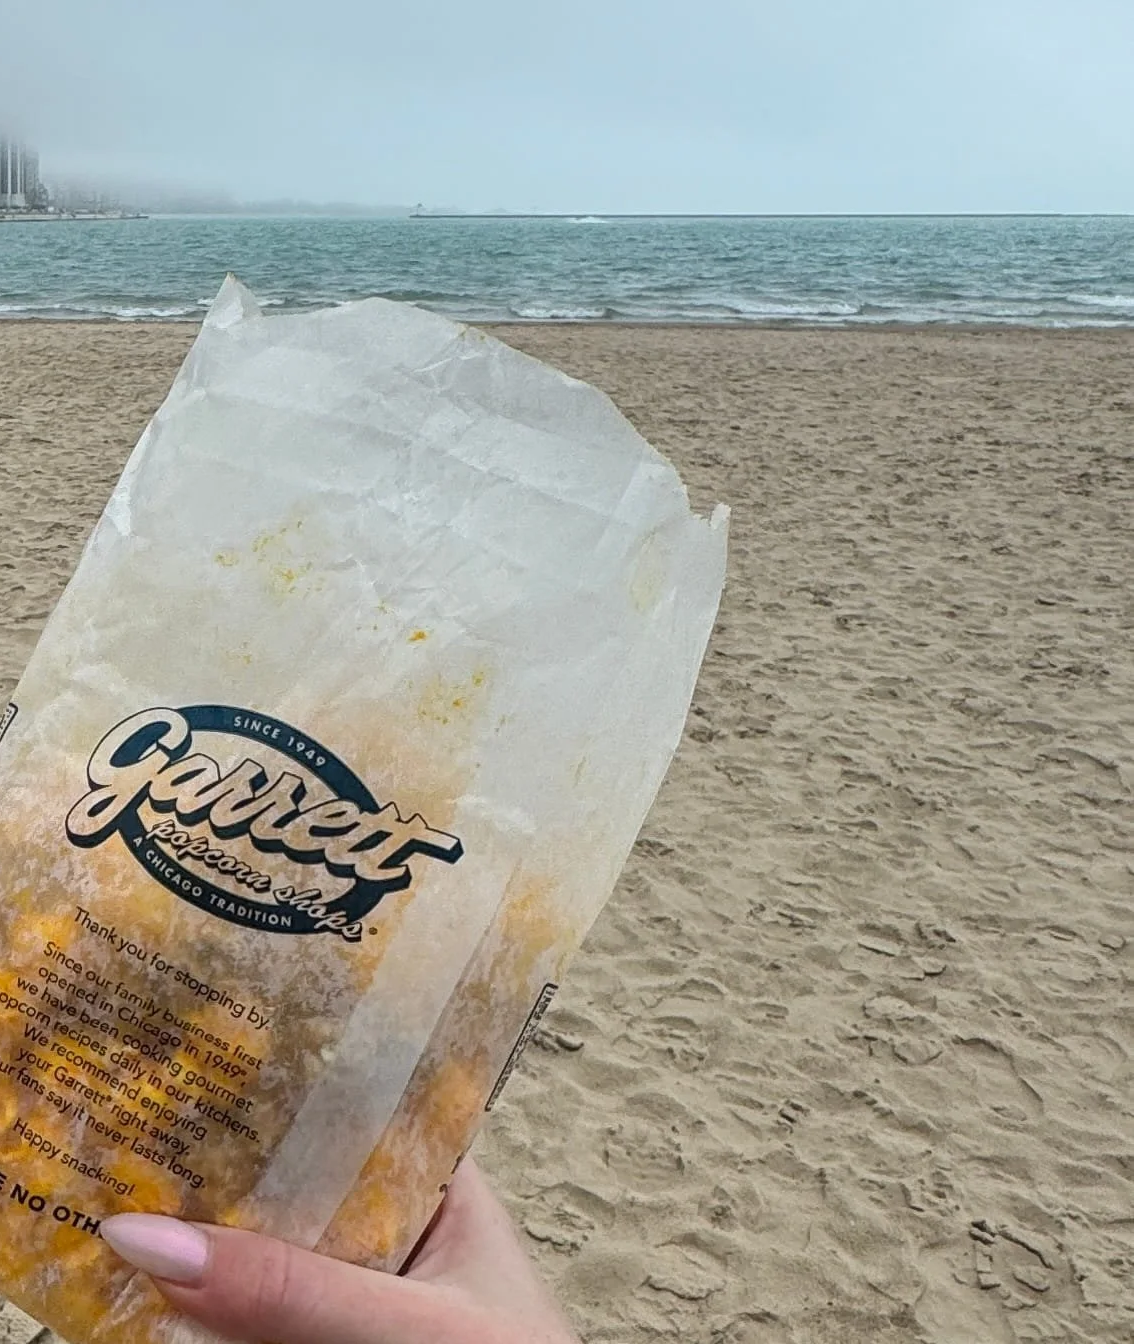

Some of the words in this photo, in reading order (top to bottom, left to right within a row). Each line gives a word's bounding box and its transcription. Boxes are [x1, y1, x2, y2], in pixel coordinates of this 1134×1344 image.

[234, 715, 281, 740] SINCE
[287, 736, 327, 768] 1949
[132, 835, 144, 848] A
[145, 849, 202, 898] CHICAGO
[210, 894, 293, 928] TRADITION
[147, 818, 272, 894] popcorn
[274, 884, 363, 942] shops
[38, 967, 98, 1005] opened
[99, 997, 114, 1013] in
[118, 1007, 182, 1047] Chicago
[184, 1039, 200, 1059] in
[43, 941, 83, 974] Since
[86, 970, 113, 989] our
[114, 981, 161, 1017] family
[162, 1008, 230, 1052] business
[233, 1044, 263, 1070] first
[74, 905, 118, 944] Thank
[116, 938, 147, 961] you
[150, 952, 174, 974] for
[174, 969, 246, 1018] stopping
[247, 1006, 270, 1030] by.
[16, 1047, 54, 1072] your
[110, 1104, 148, 1132] right
[148, 1126, 191, 1156] away.
[17, 977, 38, 995] we
[41, 987, 77, 1017] have
[79, 1008, 119, 1038] been
[122, 1034, 183, 1077] cooking
[182, 1070, 254, 1113] gourmet
[24, 1022, 49, 1046] We
[50, 1042, 141, 1101] recommend
[140, 1097, 208, 1141] enjoying
[54, 1020, 108, 1056] recipes
[110, 1051, 147, 1080] daily
[147, 1070, 163, 1090] in
[164, 1084, 194, 1104] our
[194, 1096, 261, 1143] kitchens.
[13, 1117, 61, 1160] Happy
[60, 1153, 135, 1197] snacking!
[16, 1067, 46, 1095] fans
[46, 1090, 72, 1114] say
[73, 1102, 85, 1121] it
[85, 1115, 130, 1146] never
[130, 1137, 166, 1166] lasts
[167, 1156, 206, 1189] long.
[10, 1183, 46, 1212] NO
[52, 1206, 105, 1240] OTH
